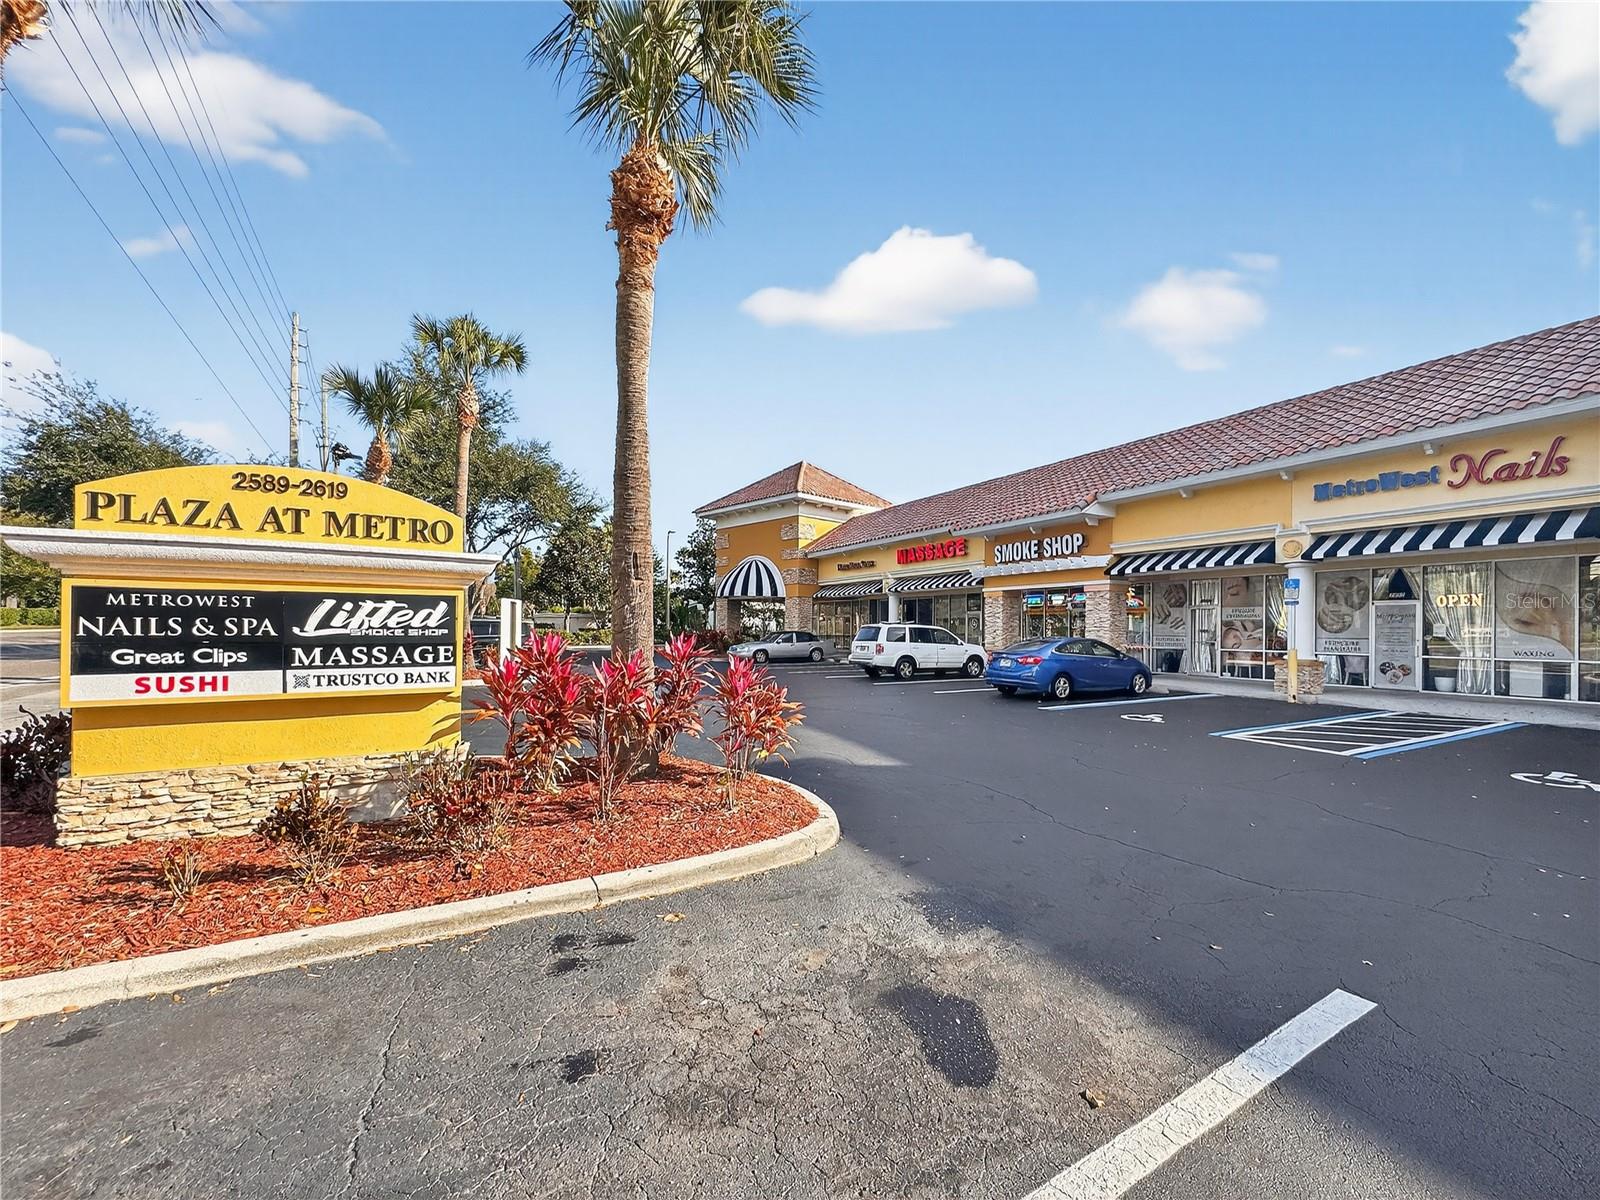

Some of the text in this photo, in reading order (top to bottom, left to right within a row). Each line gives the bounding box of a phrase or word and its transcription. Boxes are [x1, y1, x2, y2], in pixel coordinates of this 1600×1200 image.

[1313, 435, 1571, 502] MetroWest Nails
[231, 471, 348, 499] 2589-2619
[82, 490, 454, 545] PLAZA AT METRO
[896, 537, 967, 564] MASSAGE
[994, 533, 1084, 563] SMOKE SHOP
[106, 593, 255, 608] METROWEST
[1436, 592, 1483, 608] OPEN
[76, 616, 278, 637] NAILS & SPA
[292, 599, 450, 637] Lifted
[350, 628, 449, 636] SMOKE SHOP
[111, 648, 248, 667] Great Clips
[291, 645, 454, 667] MASSAGE
[1513, 649, 1555, 658] WAXING
[134, 675, 229, 694] SUSHI
[313, 671, 450, 687] TRUSTCO BANK
